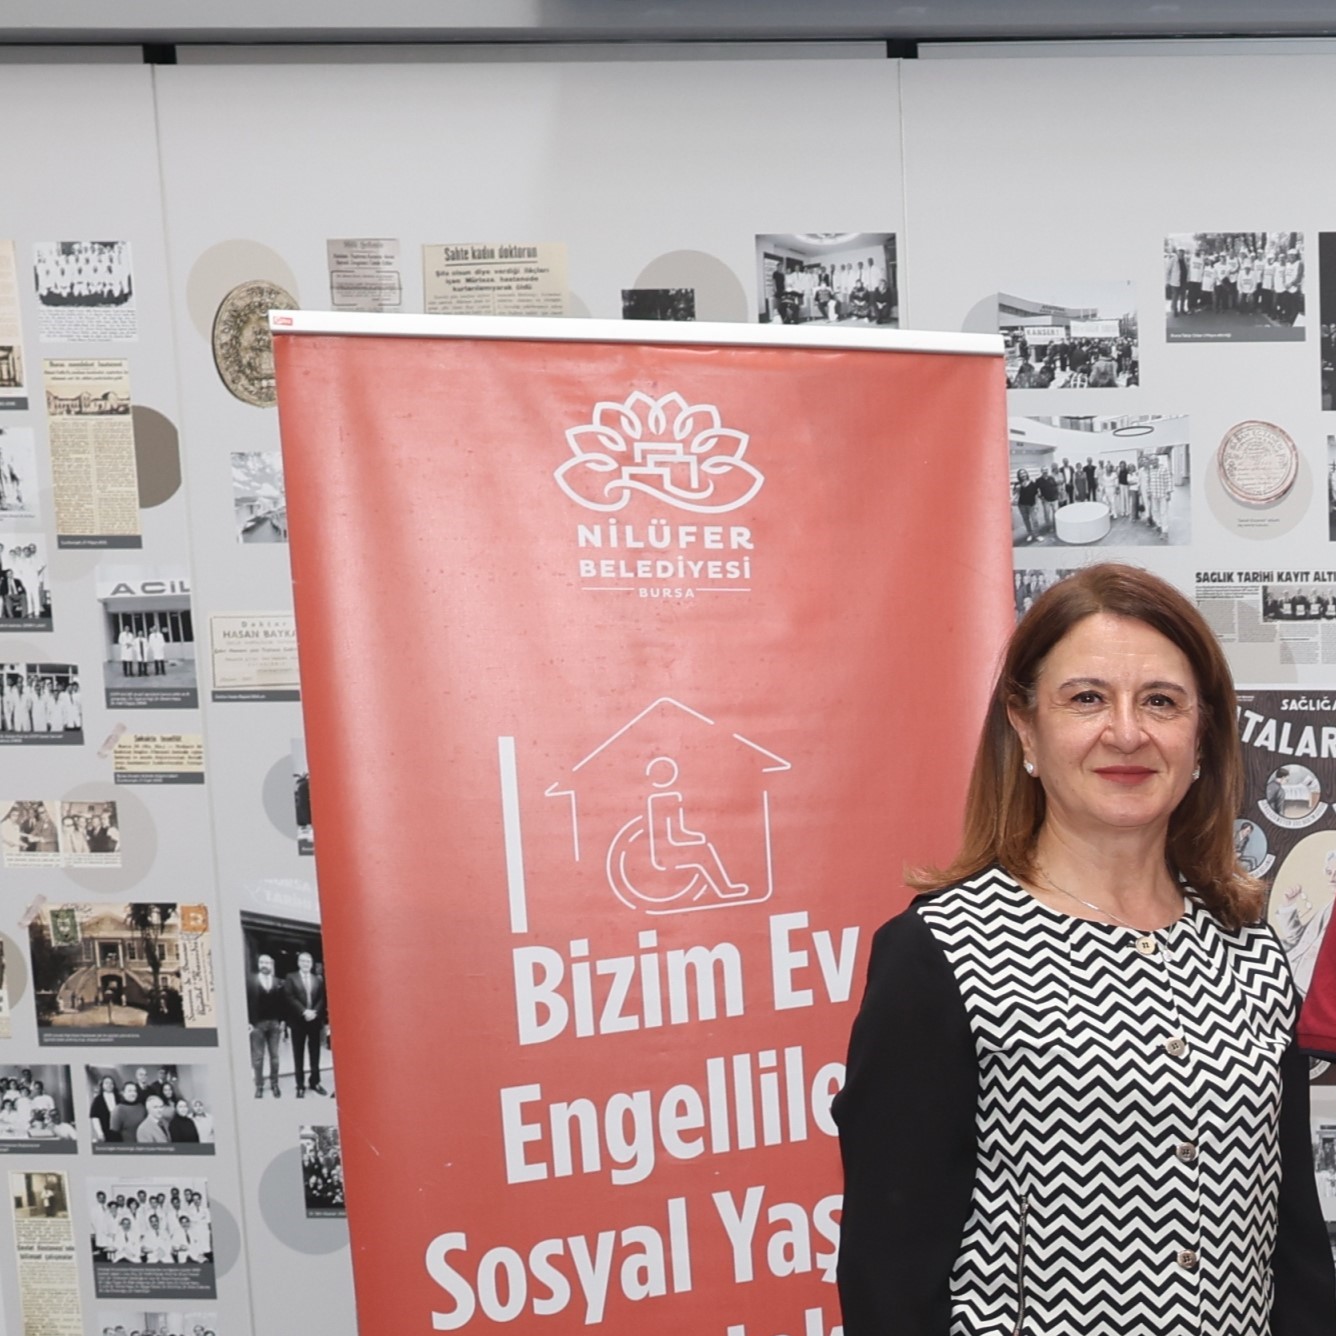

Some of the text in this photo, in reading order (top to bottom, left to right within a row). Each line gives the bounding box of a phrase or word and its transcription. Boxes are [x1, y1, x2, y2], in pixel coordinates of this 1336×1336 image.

[444, 246, 469, 261] Sahte
[577, 517, 754, 550] NİLÜFER
[579, 555, 752, 579] BELEDİYESİ
[1277, 571, 1310, 583] KAYIT
[110, 581, 190, 596] ACİL
[639, 587, 695, 598] BURSA
[223, 630, 260, 639] HASAN
[512, 910, 861, 1046] Bizim Ev
[424, 1197, 692, 1332] Sosyal
